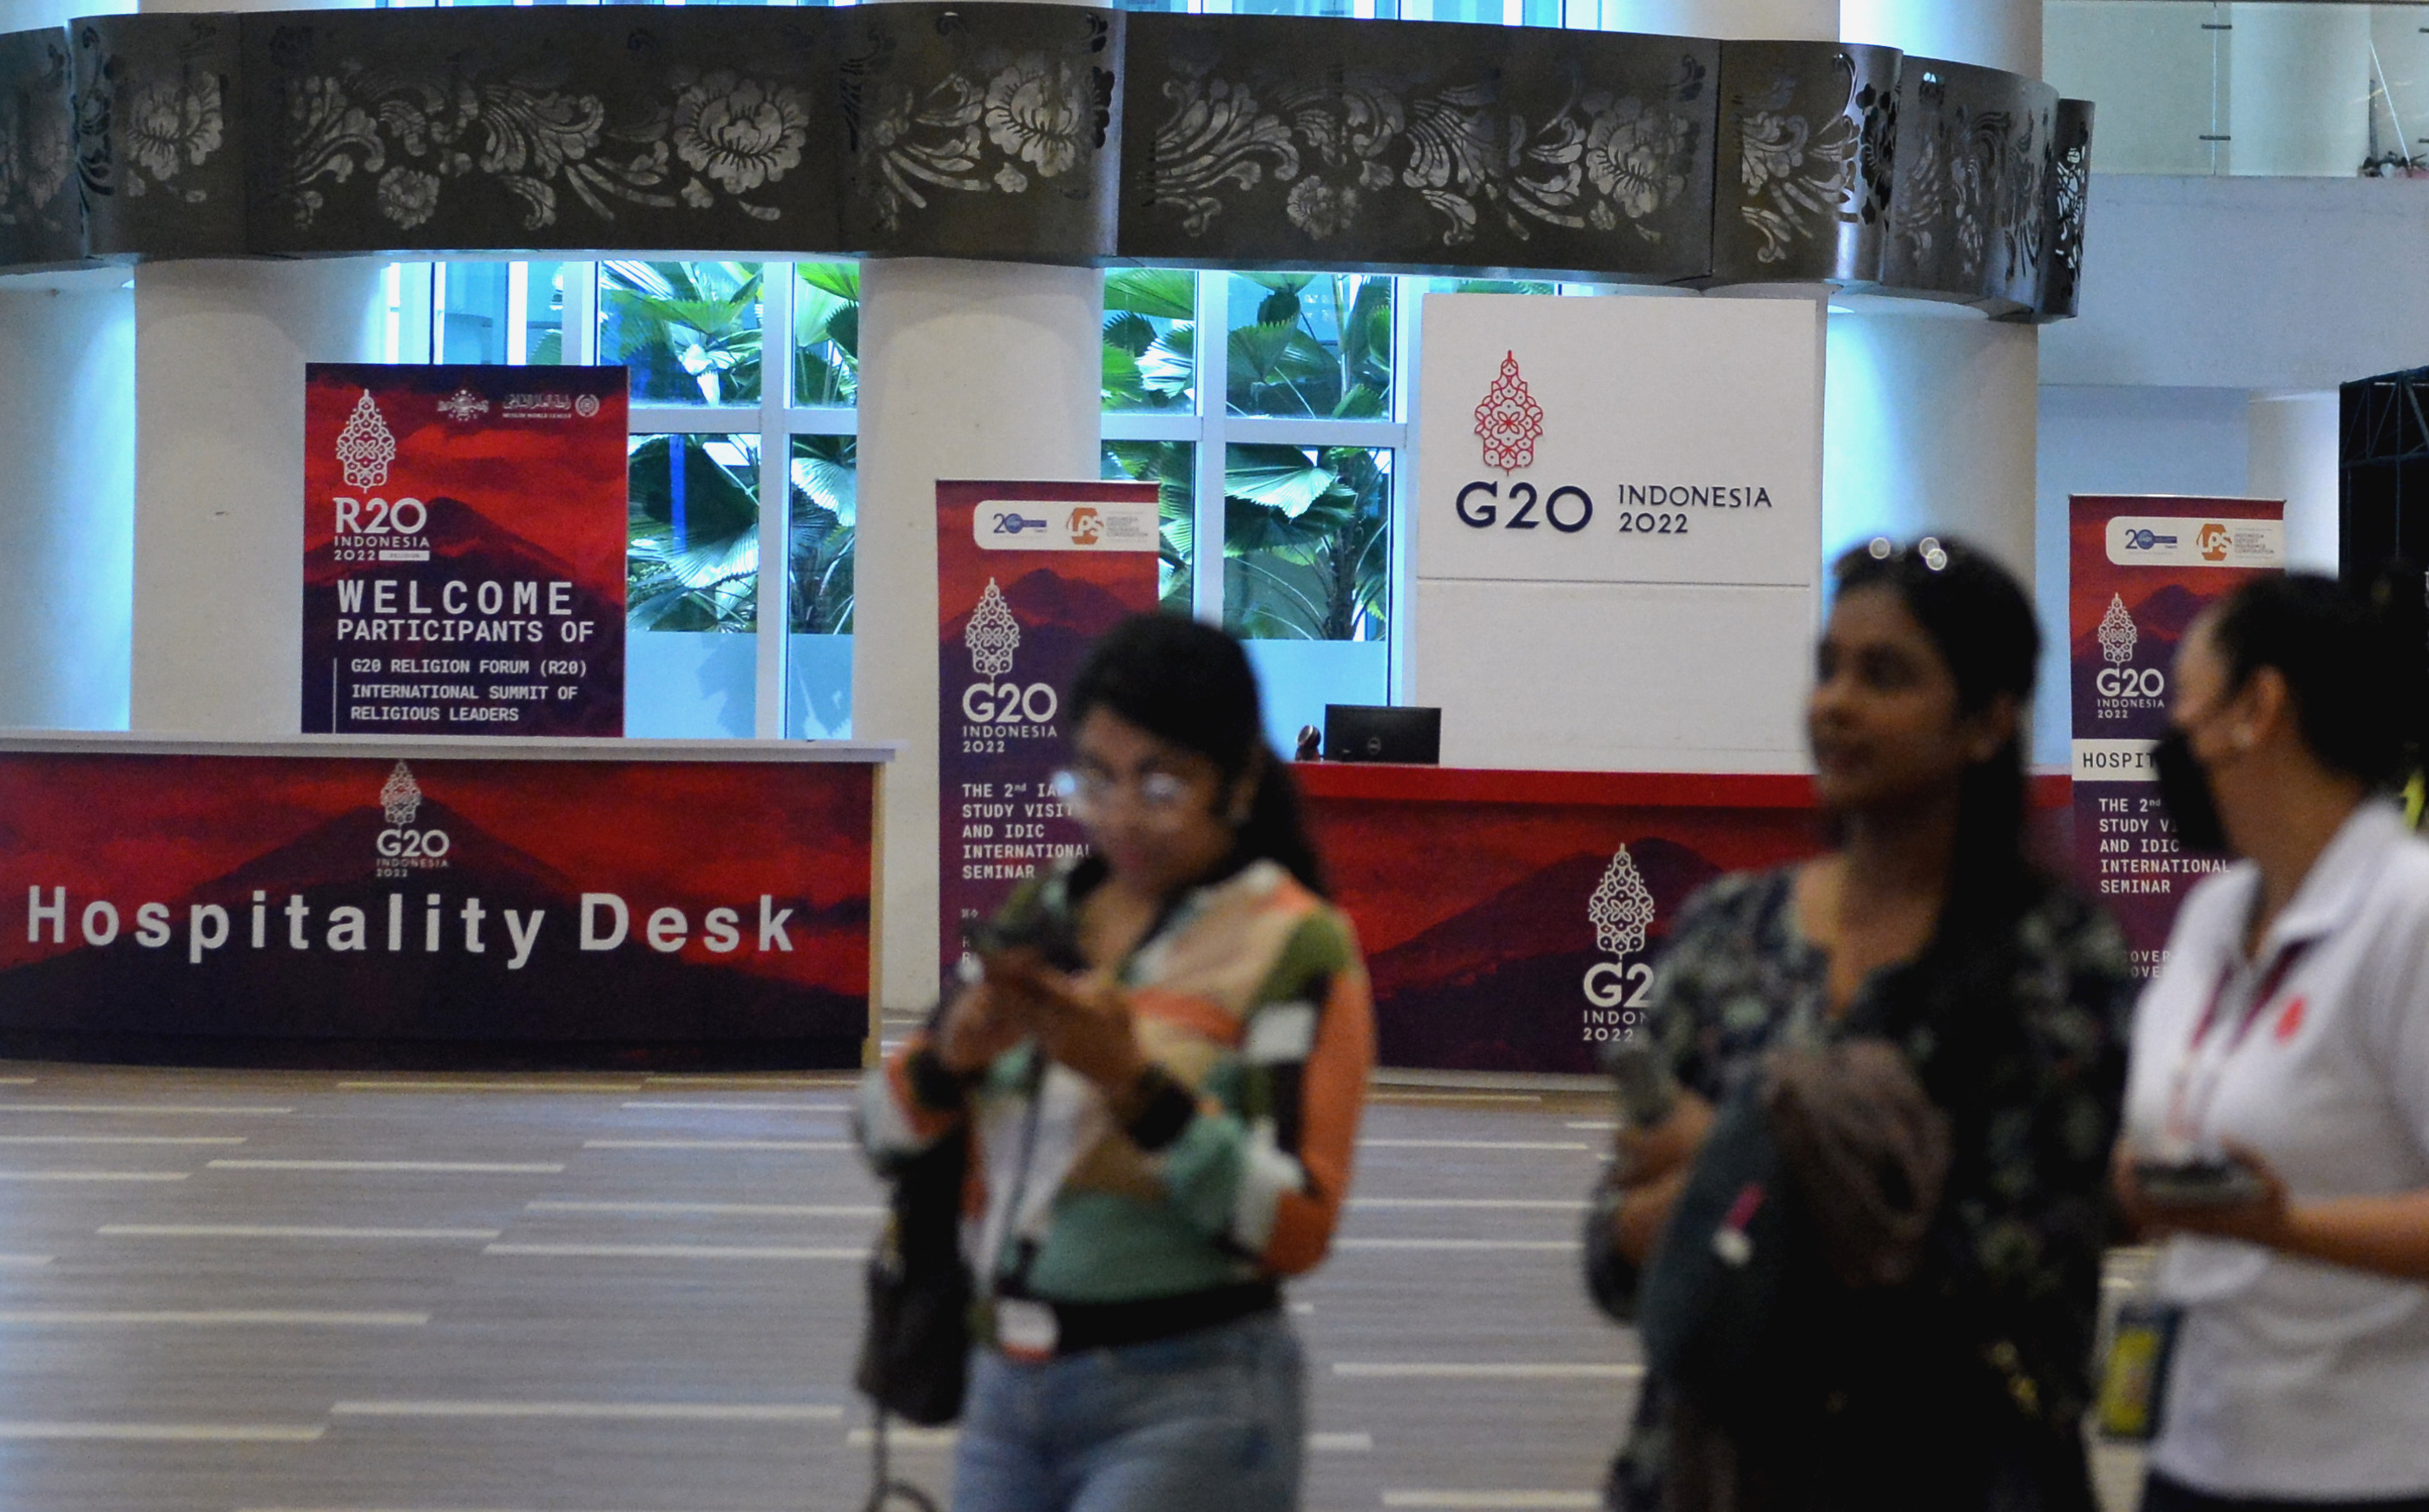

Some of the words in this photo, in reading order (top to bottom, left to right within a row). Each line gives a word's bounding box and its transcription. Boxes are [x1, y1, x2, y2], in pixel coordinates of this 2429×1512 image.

[1618, 483, 1772, 508] INDONESIA
[1456, 480, 1593, 533] G20
[332, 496, 427, 534] R20
[1619, 511, 1688, 533] 2022
[333, 536, 431, 548] INDONESIA
[333, 549, 376, 561] 2022
[337, 579, 573, 615] WELCOME
[337, 619, 543, 642] PARTICIPANTS
[561, 621, 595, 642] OF
[351, 659, 381, 673] G20
[391, 659, 471, 674] RELIGION
[479, 660, 530, 674] FORUM
[540, 660, 587, 678] (R20)
[2097, 667, 2164, 697] G20
[352, 684, 479, 700] INTERNATIONAL
[489, 686, 549, 700] SUMMIT
[557, 687, 578, 700] OF
[962, 682, 1057, 723] G20
[2097, 698, 2165, 708] INDONESIA
[350, 707, 440, 720] RELIGIOUS
[449, 707, 519, 721] LEADERS
[2097, 709, 2129, 719] 2022
[963, 726, 1057, 738] INDONESIA
[963, 740, 1005, 753] 2022
[2083, 752, 2156, 769] HOSPIT
[962, 784, 993, 798] THE
[963, 804, 1014, 818] STUDY
[2098, 799, 2129, 812] THE
[963, 825, 993, 838] AND
[1005, 825, 1044, 838] IDIC
[2099, 819, 2149, 832] STUDY
[376, 829, 450, 858] G20
[2100, 839, 2129, 853] AND
[2141, 839, 2180, 853] IDIC
[376, 858, 449, 868] INDONESIA
[2101, 859, 2230, 873] INTERNATIONAL
[376, 869, 408, 878] 2022
[963, 864, 1035, 879] SEMINAR
[2101, 879, 2170, 893] SEMINAR
[28, 885, 545, 970] Hospitality
[580, 893, 793, 953] Desk
[1583, 963, 1654, 1008] G2
[1583, 1027, 1634, 1041] 2022
